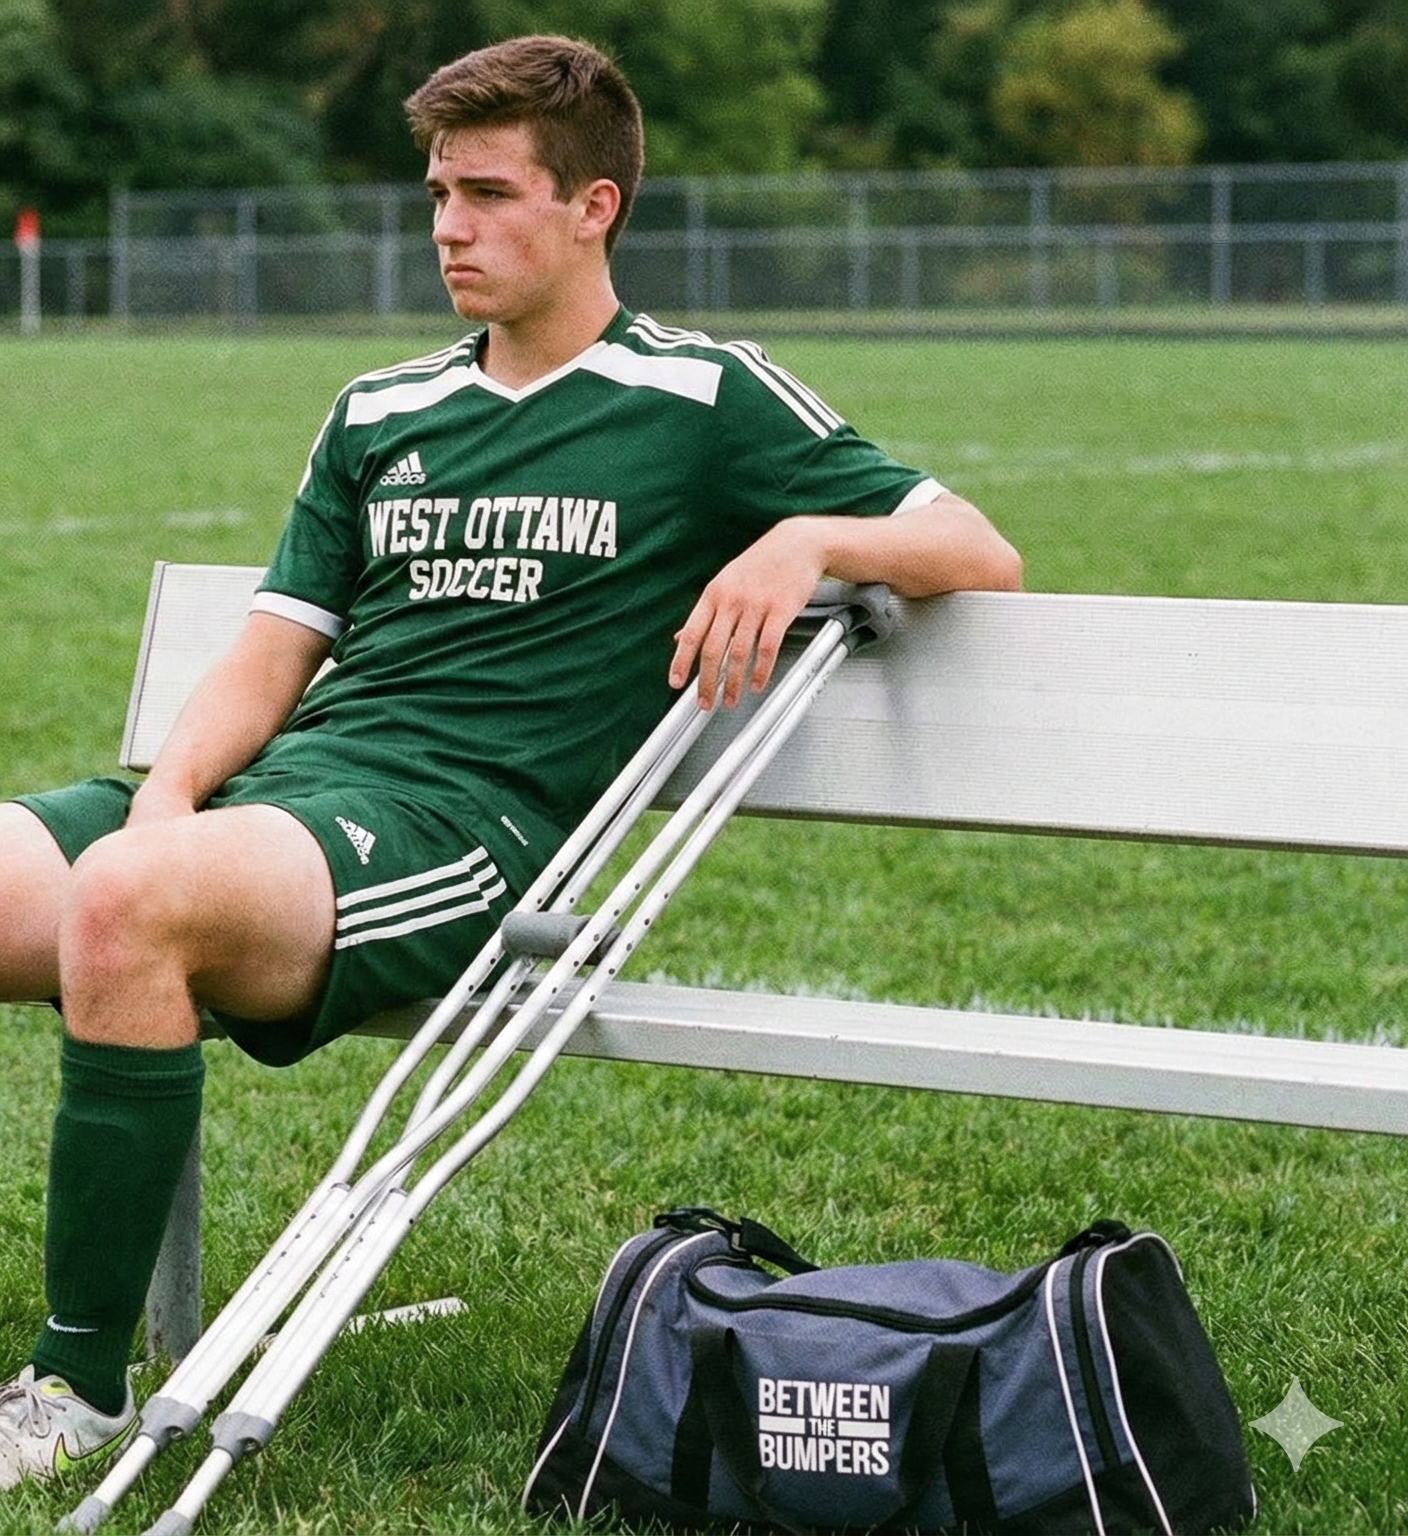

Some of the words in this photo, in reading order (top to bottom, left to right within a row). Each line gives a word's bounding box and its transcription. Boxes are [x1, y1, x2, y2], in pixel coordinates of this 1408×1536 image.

[367, 497, 460, 558] WEST
[464, 496, 618, 558] OTTAWA
[408, 557, 544, 603] SOCCER
[758, 1377, 890, 1420] BETWEEN
[808, 1418, 836, 1437] THE
[758, 1433, 890, 1476] BUMPERS
